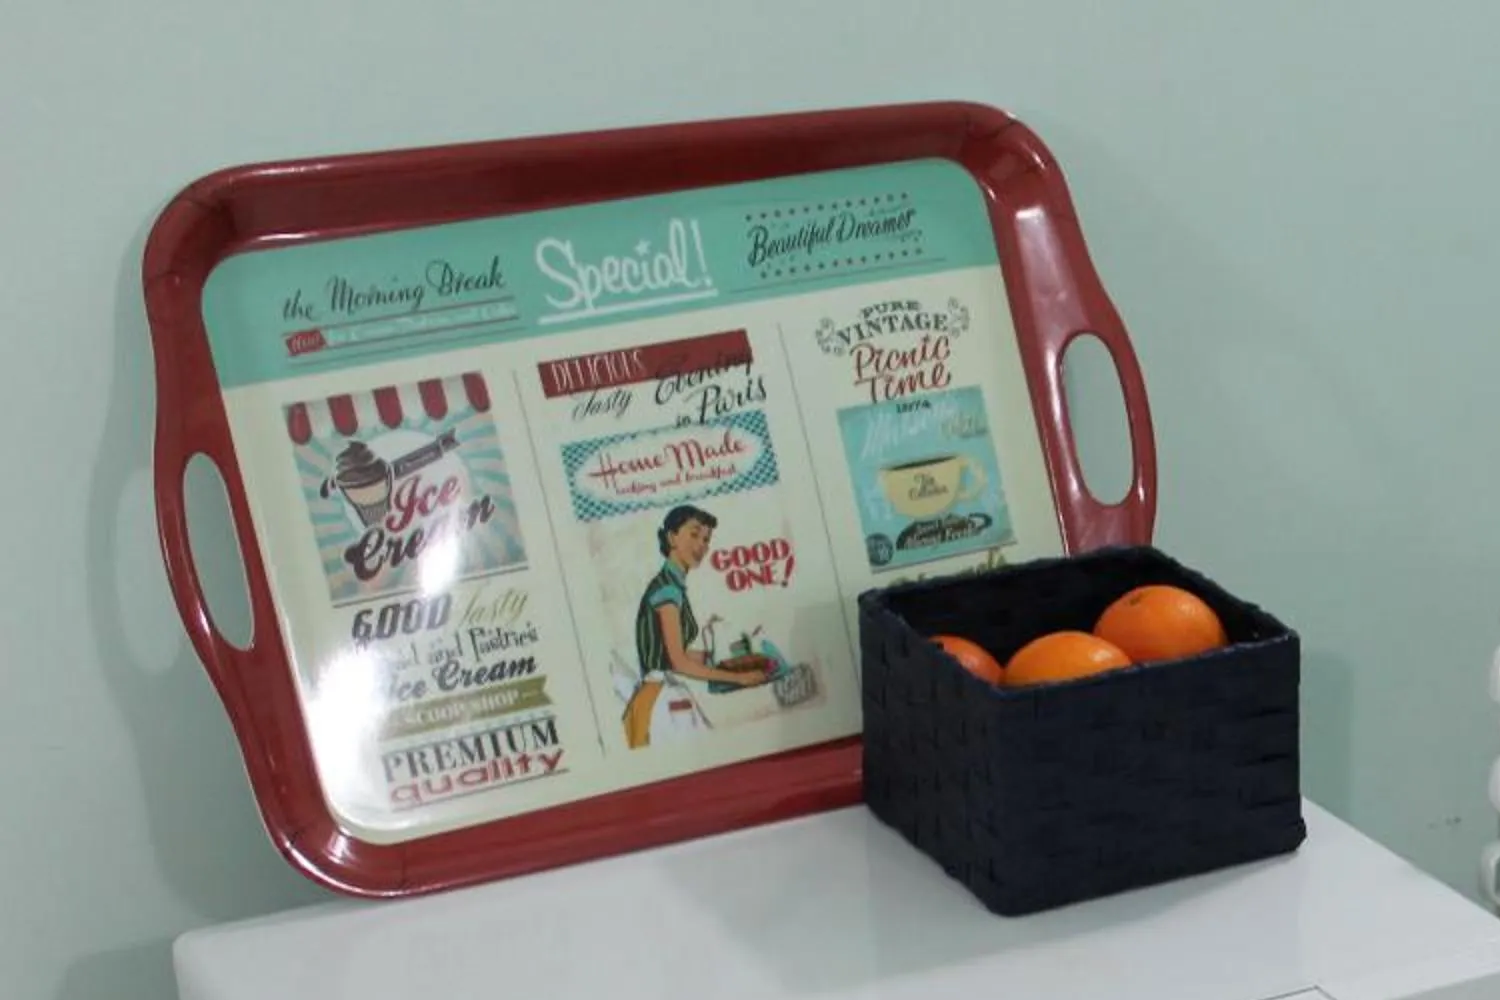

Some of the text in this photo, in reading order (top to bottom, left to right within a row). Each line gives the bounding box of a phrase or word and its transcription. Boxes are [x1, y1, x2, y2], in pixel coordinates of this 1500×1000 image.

[747, 206, 917, 268] Beautiful Dreamer
[283, 256, 506, 321] the Morning Break
[535, 218, 714, 312] Special!
[836, 312, 950, 346] VINTAGE
[860, 299, 920, 319] PURE
[551, 349, 647, 393] DELICIOUS
[849, 333, 951, 385] Picnic
[853, 364, 952, 404] Time
[682, 375, 767, 424] Paris
[587, 428, 749, 489] Home Made
[386, 473, 462, 533] Ice
[711, 538, 790, 573] GOOD
[431, 655, 537, 692] Cream
[381, 715, 561, 783] PREMIUM
[390, 748, 566, 807] quality
